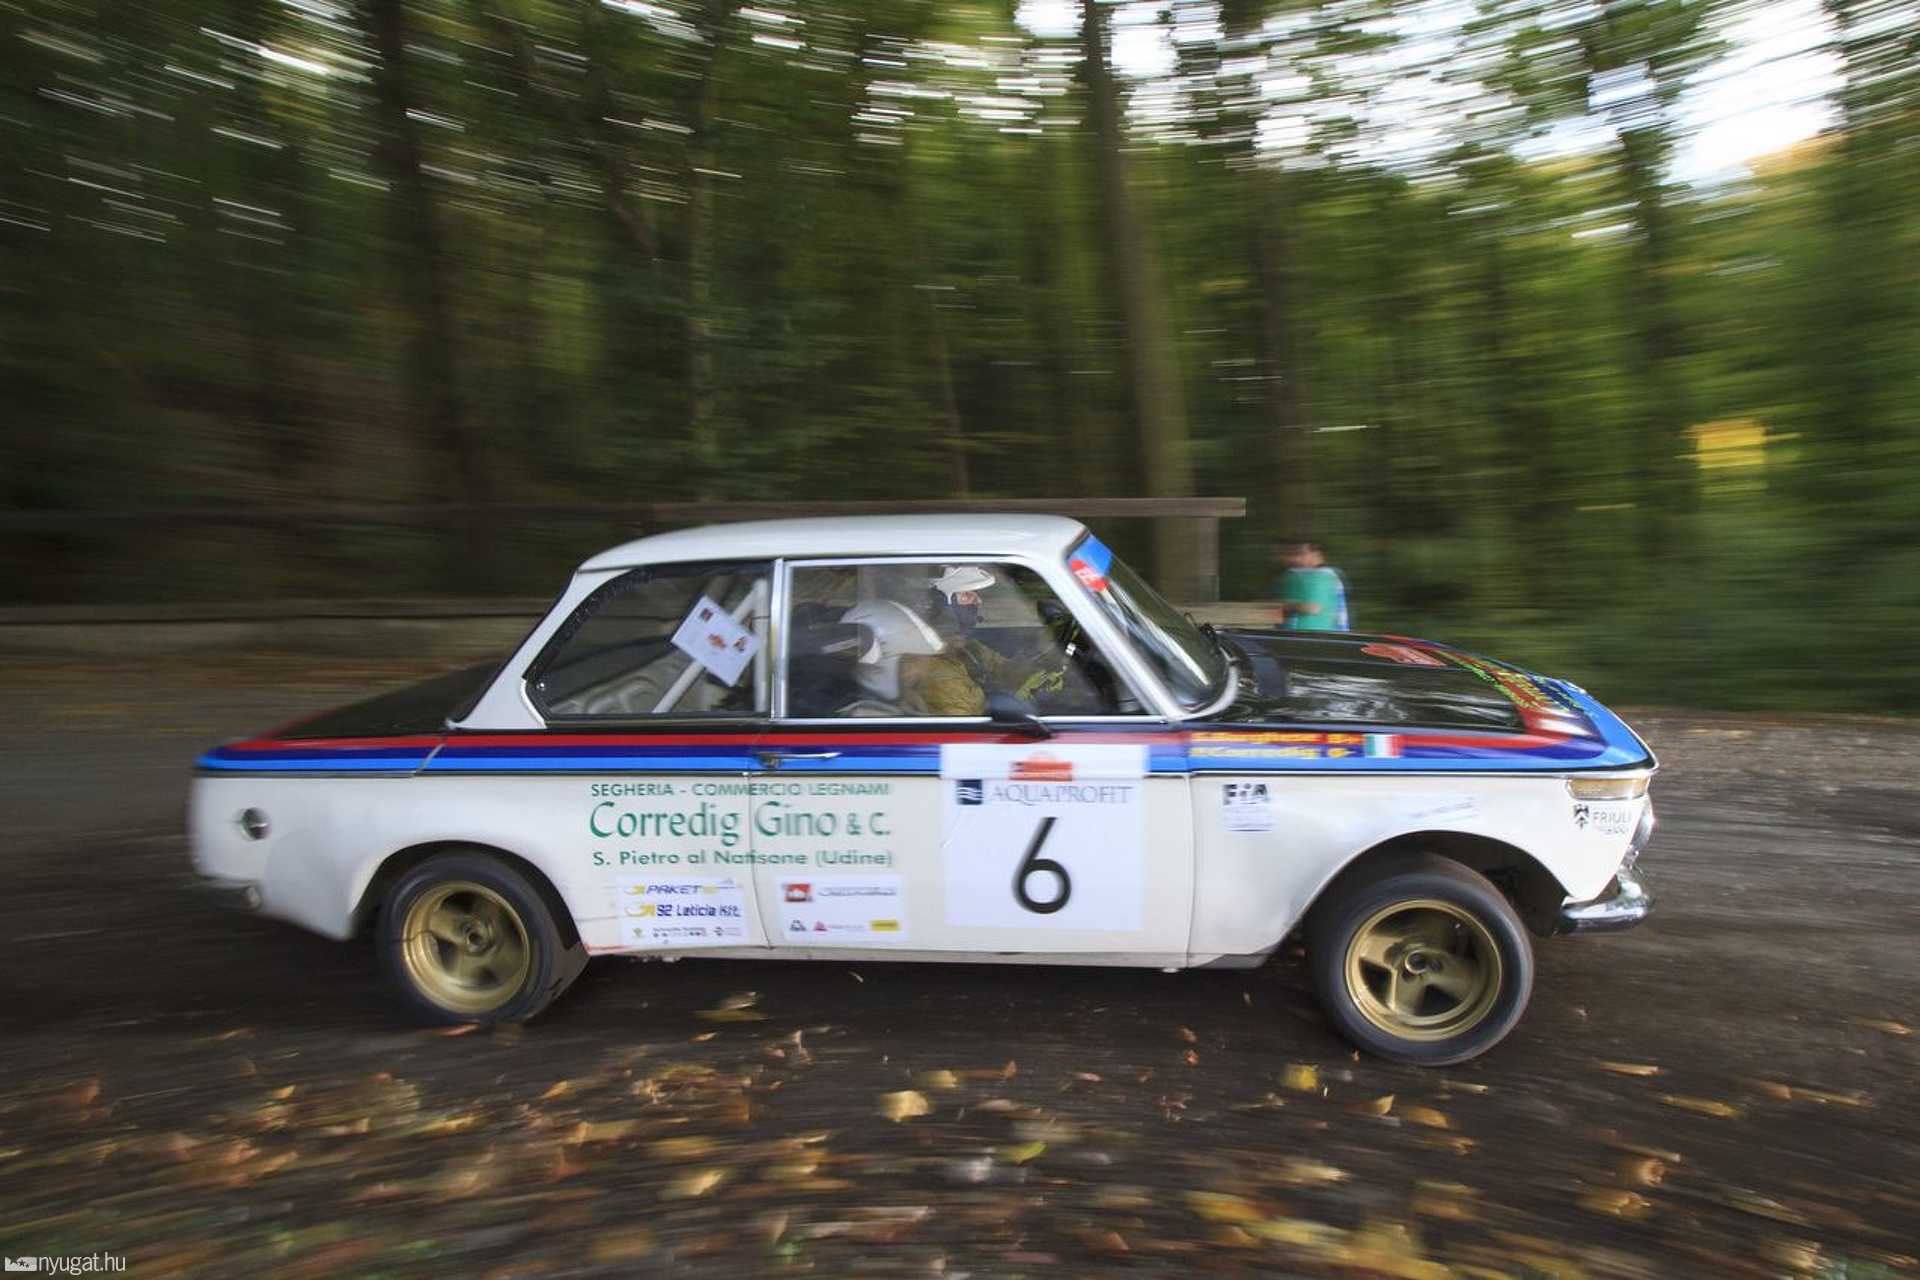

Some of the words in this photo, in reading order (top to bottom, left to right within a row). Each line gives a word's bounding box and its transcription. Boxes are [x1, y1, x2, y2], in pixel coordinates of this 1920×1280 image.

[591, 783, 674, 797] SEGHERIA
[692, 783, 801, 796] COMMERCIO
[808, 783, 890, 796] LEGNAMI
[992, 784, 1133, 806] AQUAPROFIT
[590, 801, 740, 847] Corredig
[754, 800, 837, 836] Gino
[847, 812, 861, 836] &
[869, 812, 891, 836] C.
[593, 851, 611, 866] S.
[620, 850, 680, 865] Pietro
[687, 850, 705, 864] al
[714, 850, 808, 865] Natisone
[816, 850, 893, 868] (Udine)
[1012, 816, 1072, 915] 6
[677, 903, 717, 917] Leticia
